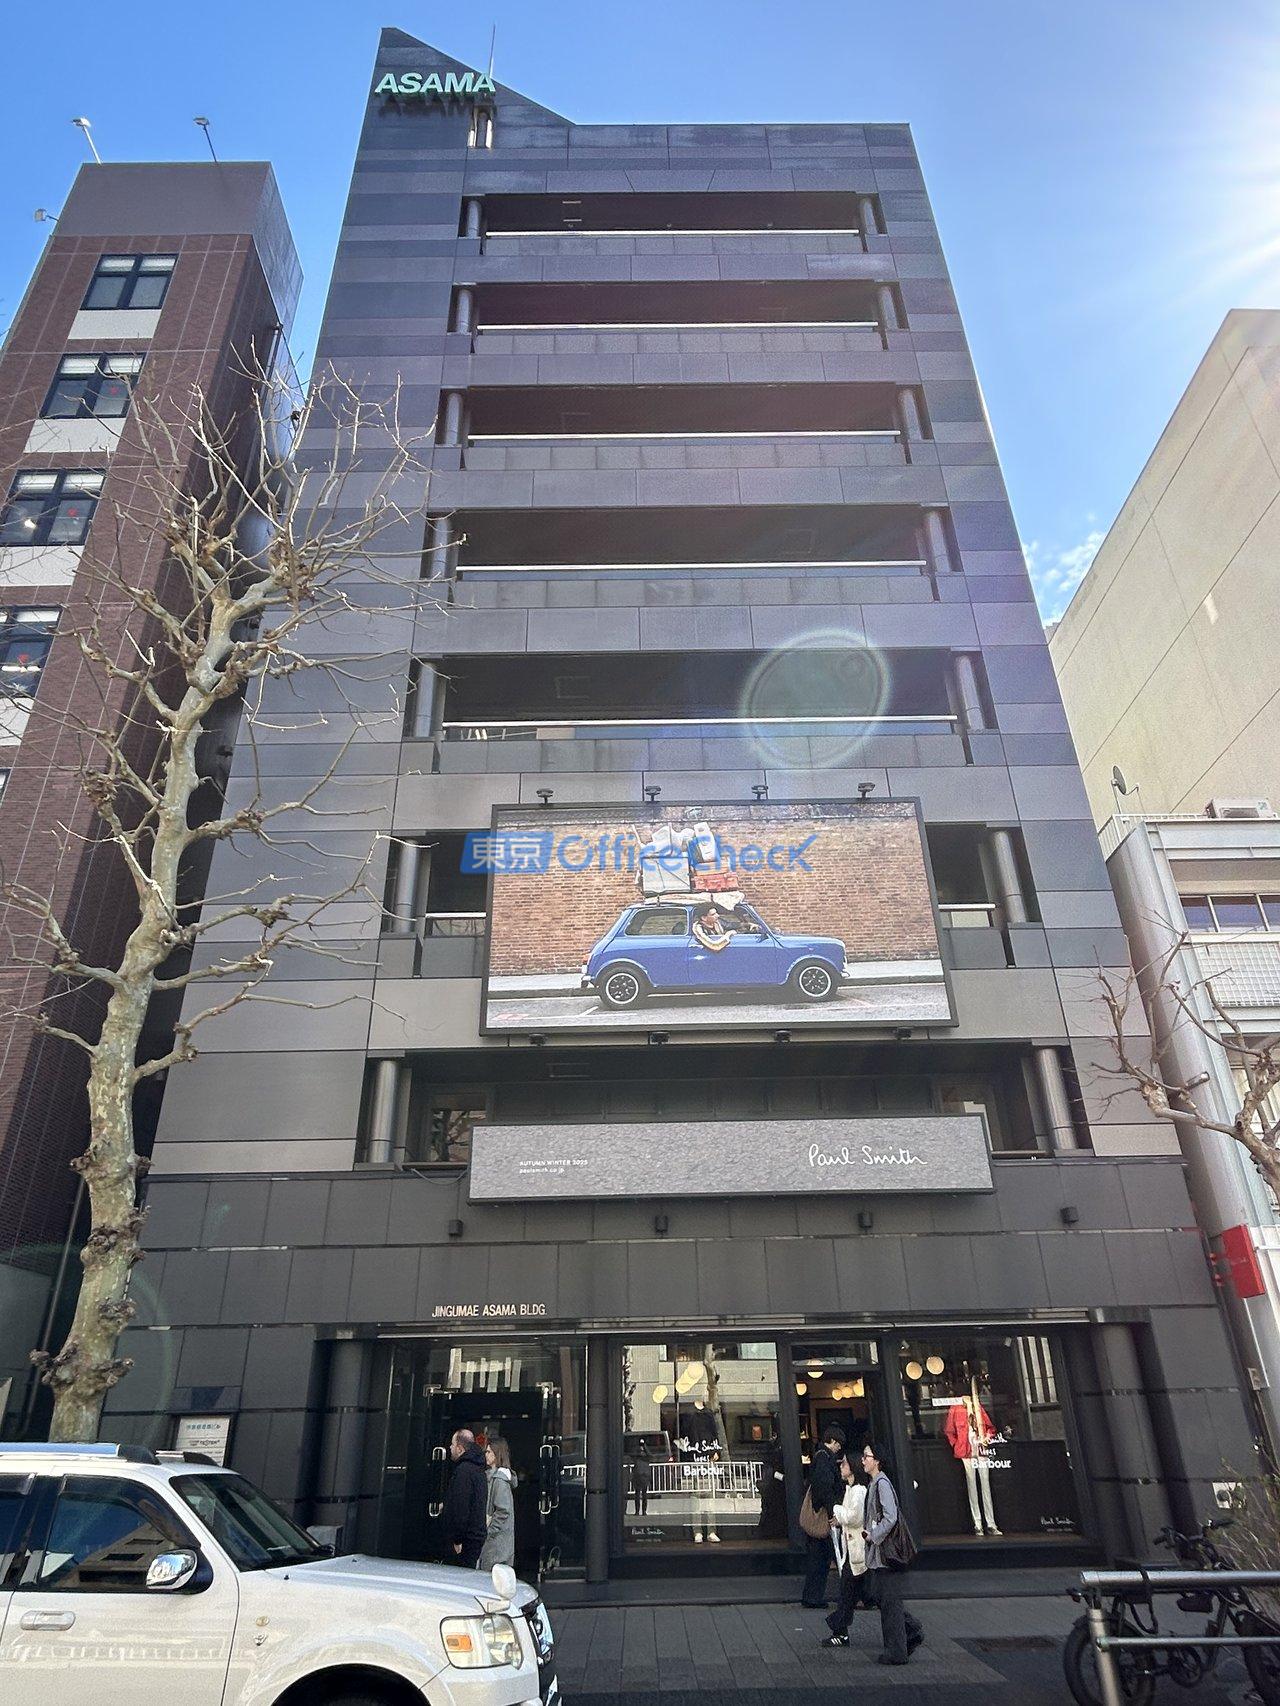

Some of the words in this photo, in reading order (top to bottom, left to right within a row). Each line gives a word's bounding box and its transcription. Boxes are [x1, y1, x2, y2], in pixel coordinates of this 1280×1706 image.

[374, 72, 496, 93] ASAMA
[808, 1143, 856, 1167] Paul
[861, 1145, 928, 1165] Smith
[432, 1305, 480, 1318] JINGUMAE
[482, 1304, 517, 1316] ASAMA
[683, 1464, 725, 1477] Barbour
[971, 1458, 1012, 1469] Barbour
